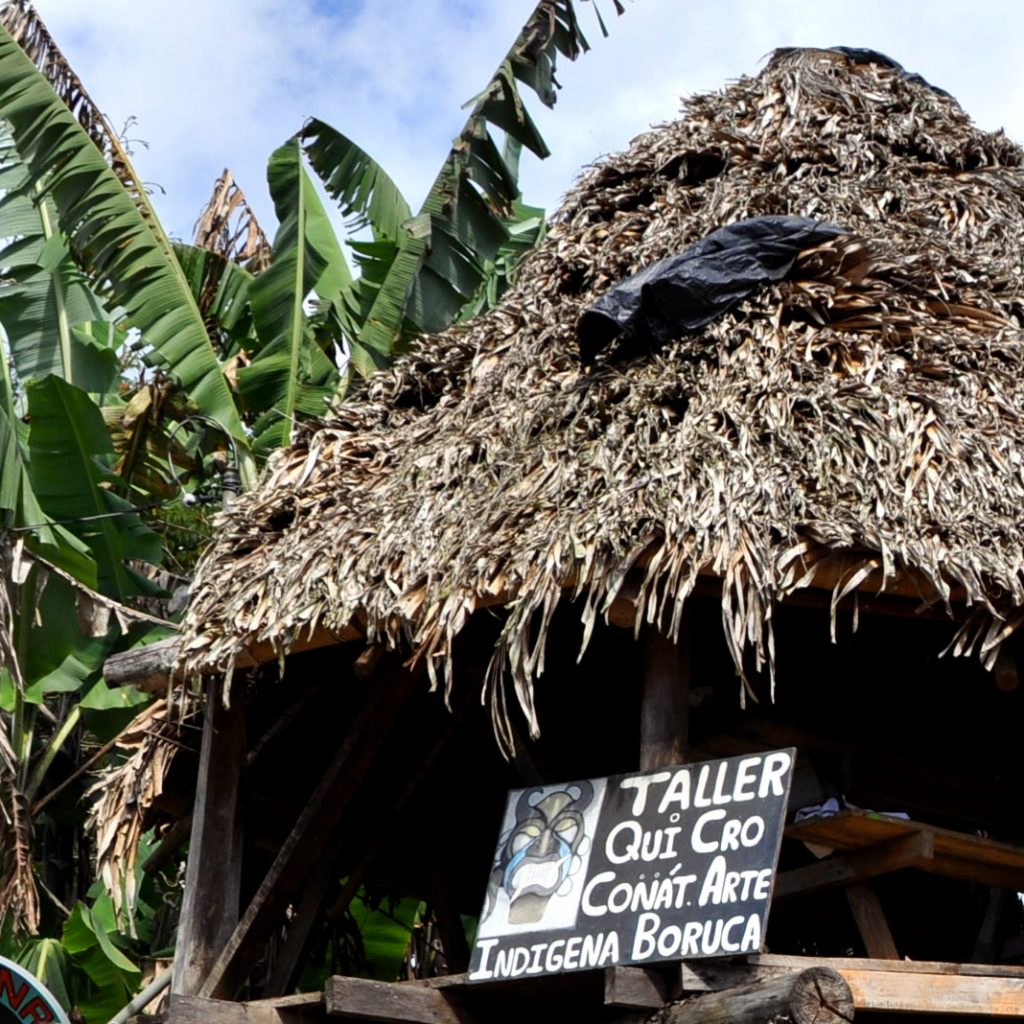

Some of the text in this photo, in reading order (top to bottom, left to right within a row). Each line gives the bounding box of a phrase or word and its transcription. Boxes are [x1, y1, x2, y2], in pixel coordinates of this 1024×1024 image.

[620, 752, 791, 816] TALLER
[691, 809, 765, 853] CRO
[699, 855, 772, 906] ARTE
[469, 912, 762, 980] INDIGENA BORUCA
